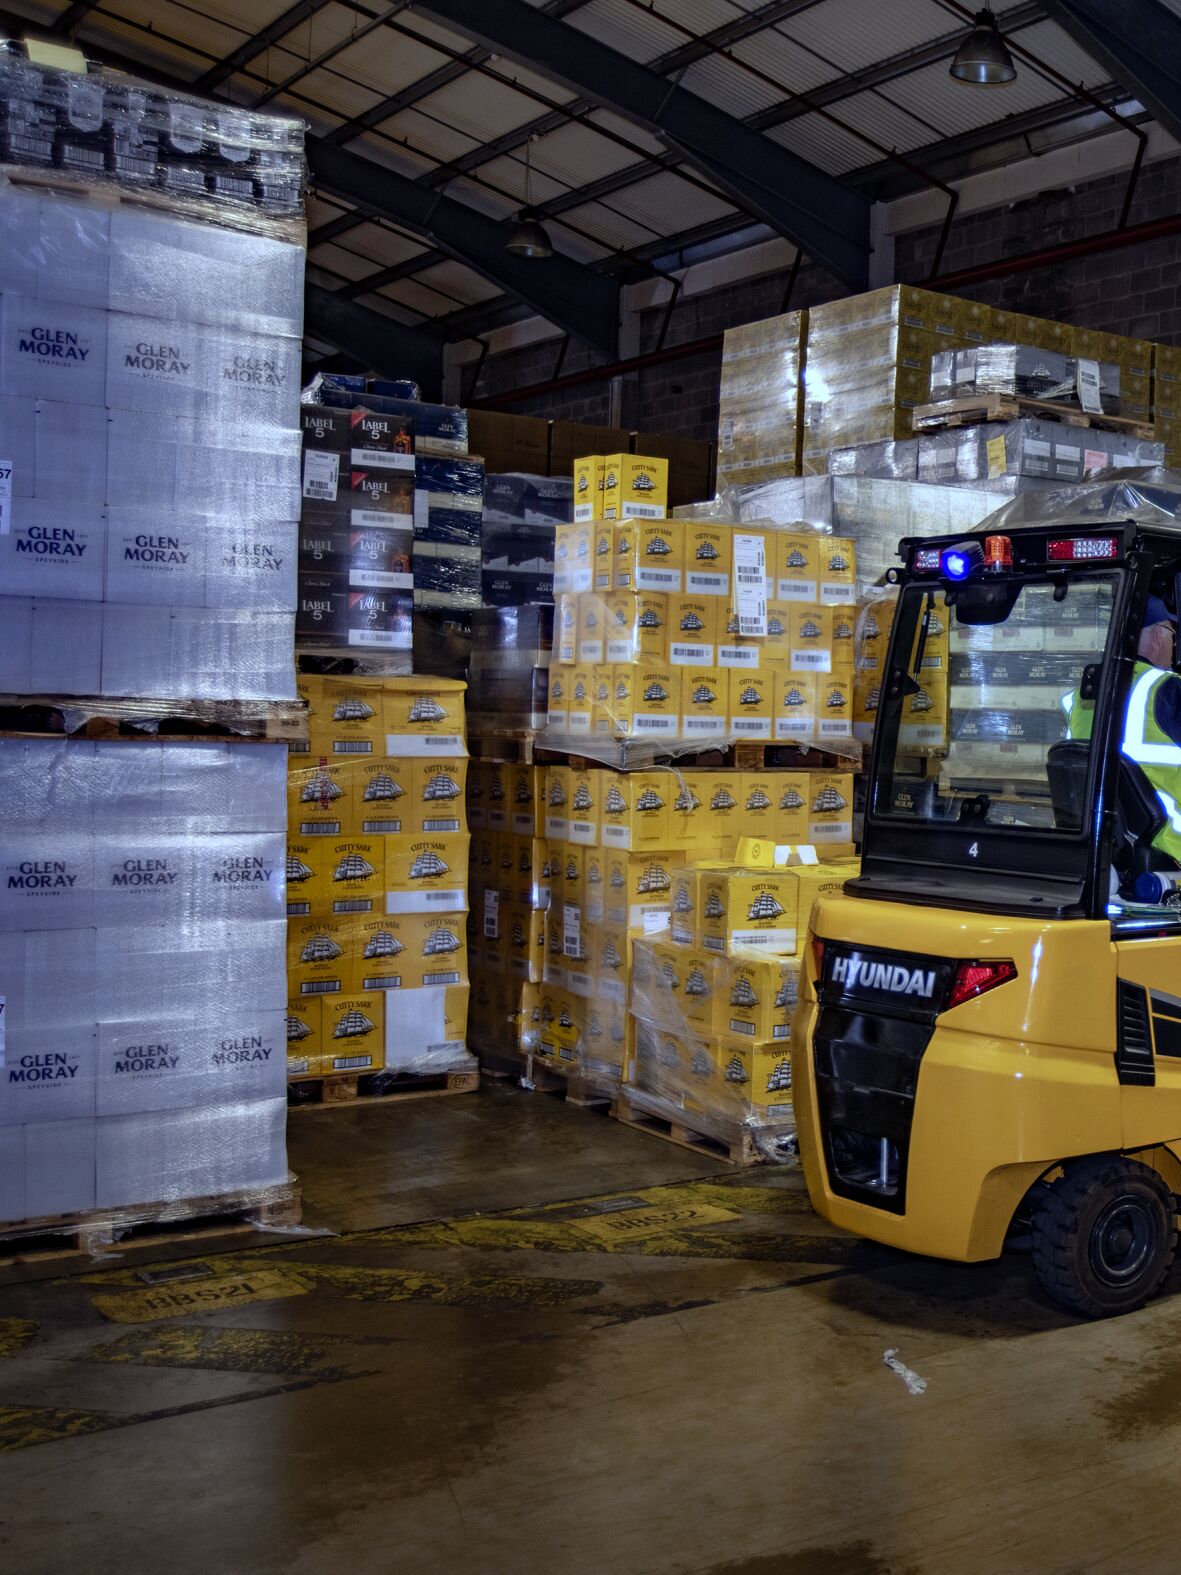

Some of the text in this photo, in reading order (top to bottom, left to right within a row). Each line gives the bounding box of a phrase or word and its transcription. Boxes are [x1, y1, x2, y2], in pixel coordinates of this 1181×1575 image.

[31, 328, 78, 345] GLEN
[19, 340, 90, 360] MORAY
[136, 342, 180, 359] GLEN
[38, 358, 72, 367] SPEYSIDE
[124, 355, 190, 374] MORAY
[234, 356, 275, 372] GLEN
[223, 368, 286, 386] MORAY
[306, 416, 336, 430] LABEL
[362, 420, 390, 433] LABEL
[315, 428, 325, 438] 5
[371, 430, 380, 439] 5
[362, 480, 390, 493] LABEL
[371, 490, 380, 500] 5
[28, 526, 75, 542] GLEN
[660, 528, 672, 536] SARK
[136, 535, 179, 549] GLEN
[303, 539, 334, 552] LABEL
[360, 540, 388, 552] LABEL
[16, 541, 87, 557] MORAY
[314, 550, 323, 559] 5
[369, 551, 378, 559] 5
[124, 549, 189, 564] MORAY
[222, 556, 284, 570] MORAY
[303, 600, 334, 612] LABEL
[360, 600, 388, 612] LABEL
[313, 611, 322, 620] 5
[369, 610, 377, 619] 5
[364, 764, 400, 774] CUTTY SARK
[424, 765, 459, 773] CUTTY SARK
[335, 844, 372, 853] CUTTY SARK
[411, 843, 447, 852] CUTTY SARK
[969, 842, 978, 857] 4
[20, 861, 66, 873] GLEN
[124, 859, 167, 872] GLEN
[223, 857, 264, 869] GLEN
[8, 874, 77, 889] MORAY
[112, 872, 178, 886] MORAY
[212, 869, 273, 883] MORAY
[818, 884, 834, 892] CUTTY
[301, 924, 339, 934] CUTTY SARK
[364, 920, 400, 931] CUTTY SARK
[424, 919, 459, 928] CUTTY SARK
[832, 956, 936, 997] HYUNDAI
[291, 1005, 308, 1013] SARK
[336, 1001, 372, 1011] CUTTY SARK
[221, 1036, 262, 1050] GLEN
[125, 1045, 169, 1059] GLEN
[211, 1048, 272, 1064] MORAY
[771, 1050, 788, 1058] CUTTY
[20, 1053, 68, 1068] GLEN
[114, 1056, 180, 1074] MORAY
[8, 1066, 78, 1083] MORAY
[145, 1282, 257, 1310] BBS21
